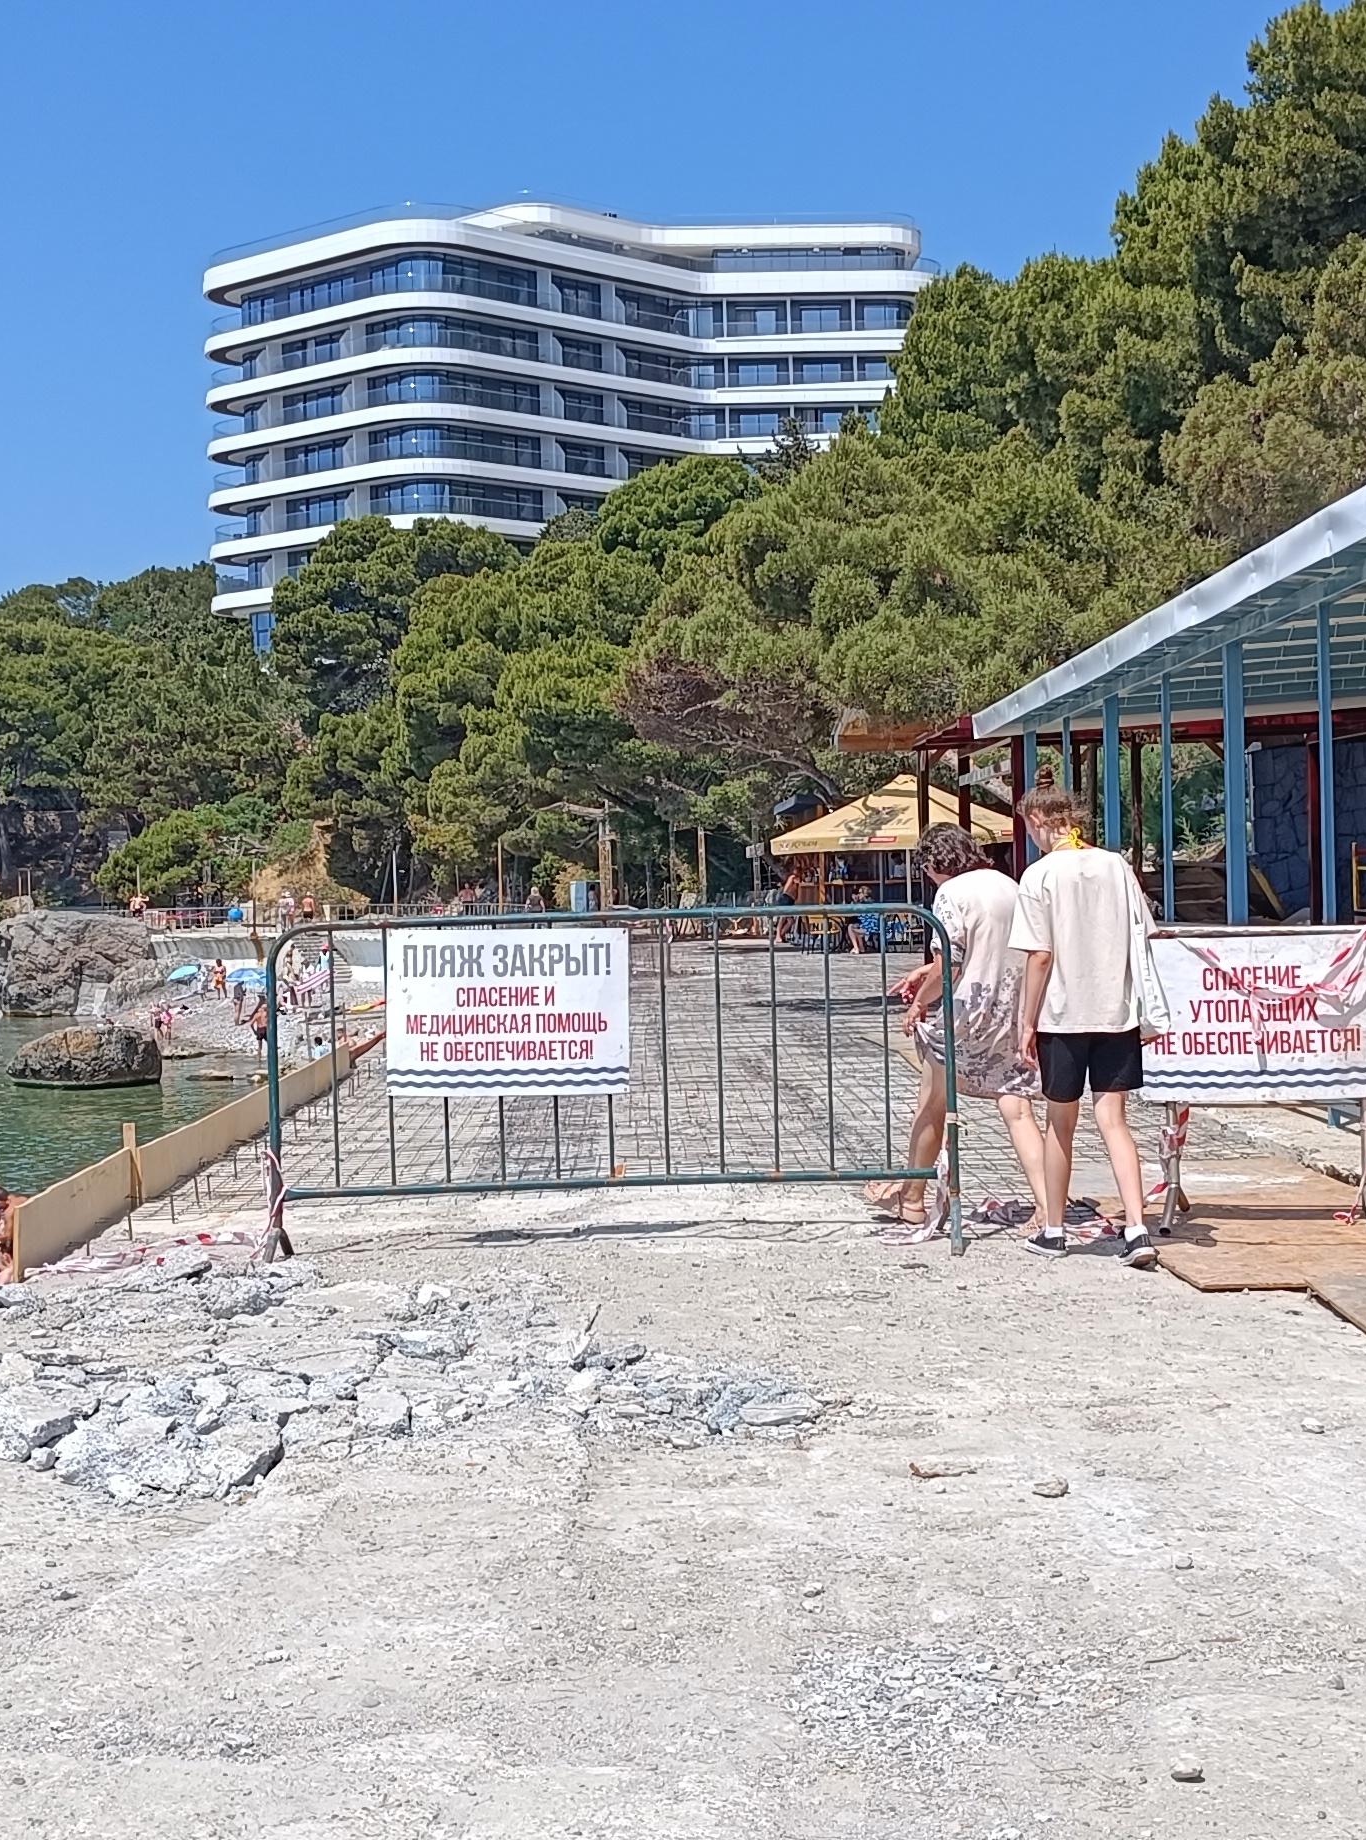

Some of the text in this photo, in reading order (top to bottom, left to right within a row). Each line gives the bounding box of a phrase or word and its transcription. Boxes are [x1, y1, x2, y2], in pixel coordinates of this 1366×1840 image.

[402, 943, 612, 978] ПЛЯЖ ЗАКРЫТ!
[1202, 965, 1303, 991] СПАСЕНИЕ
[456, 985, 555, 1007] СПАСЕНИЕ И
[406, 1012, 608, 1037] МЕДИЦИНСКАЯ ПОМОЩЬ
[420, 1040, 594, 1062] НЕ ОБЕСПЕЧИВАЕТСЯ!
[1154, 1028, 1361, 1056] НЕ ОБЕСПЕЧИВАЕТСЯ!
